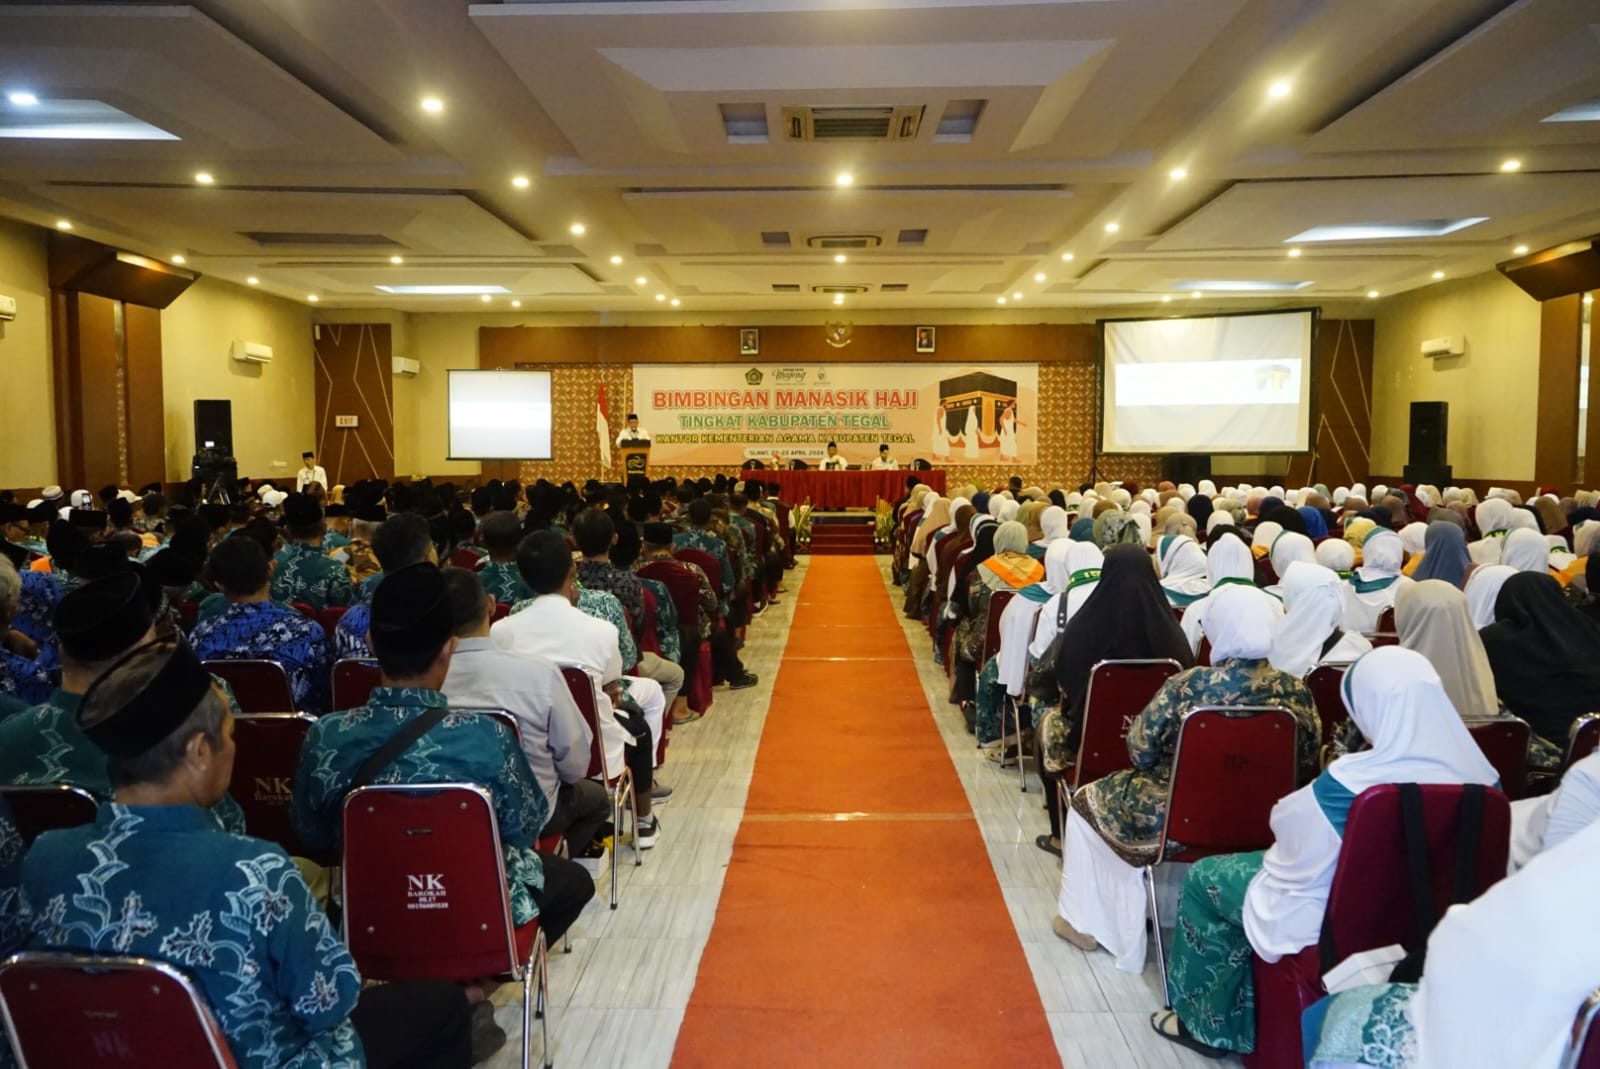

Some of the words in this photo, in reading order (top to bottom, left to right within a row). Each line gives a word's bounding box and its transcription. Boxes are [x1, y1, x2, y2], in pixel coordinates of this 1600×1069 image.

[653, 391, 769, 409] BIMBINGAN
[776, 391, 868, 408] MANASIK
[875, 391, 918, 408] HAJI
[680, 415, 743, 429] TINGKAT
[748, 415, 838, 428] KABUPATEN
[842, 415, 890, 428] TEGAL
[655, 433, 699, 444] KANTOR
[701, 433, 774, 444] KEMENTERIAN
[776, 433, 816, 444] AGAMA
[818, 433, 879, 443] KABUPATEN
[881, 433, 915, 443] TEGAL
[255, 777, 292, 793] NK
[407, 873, 446, 890] NK
